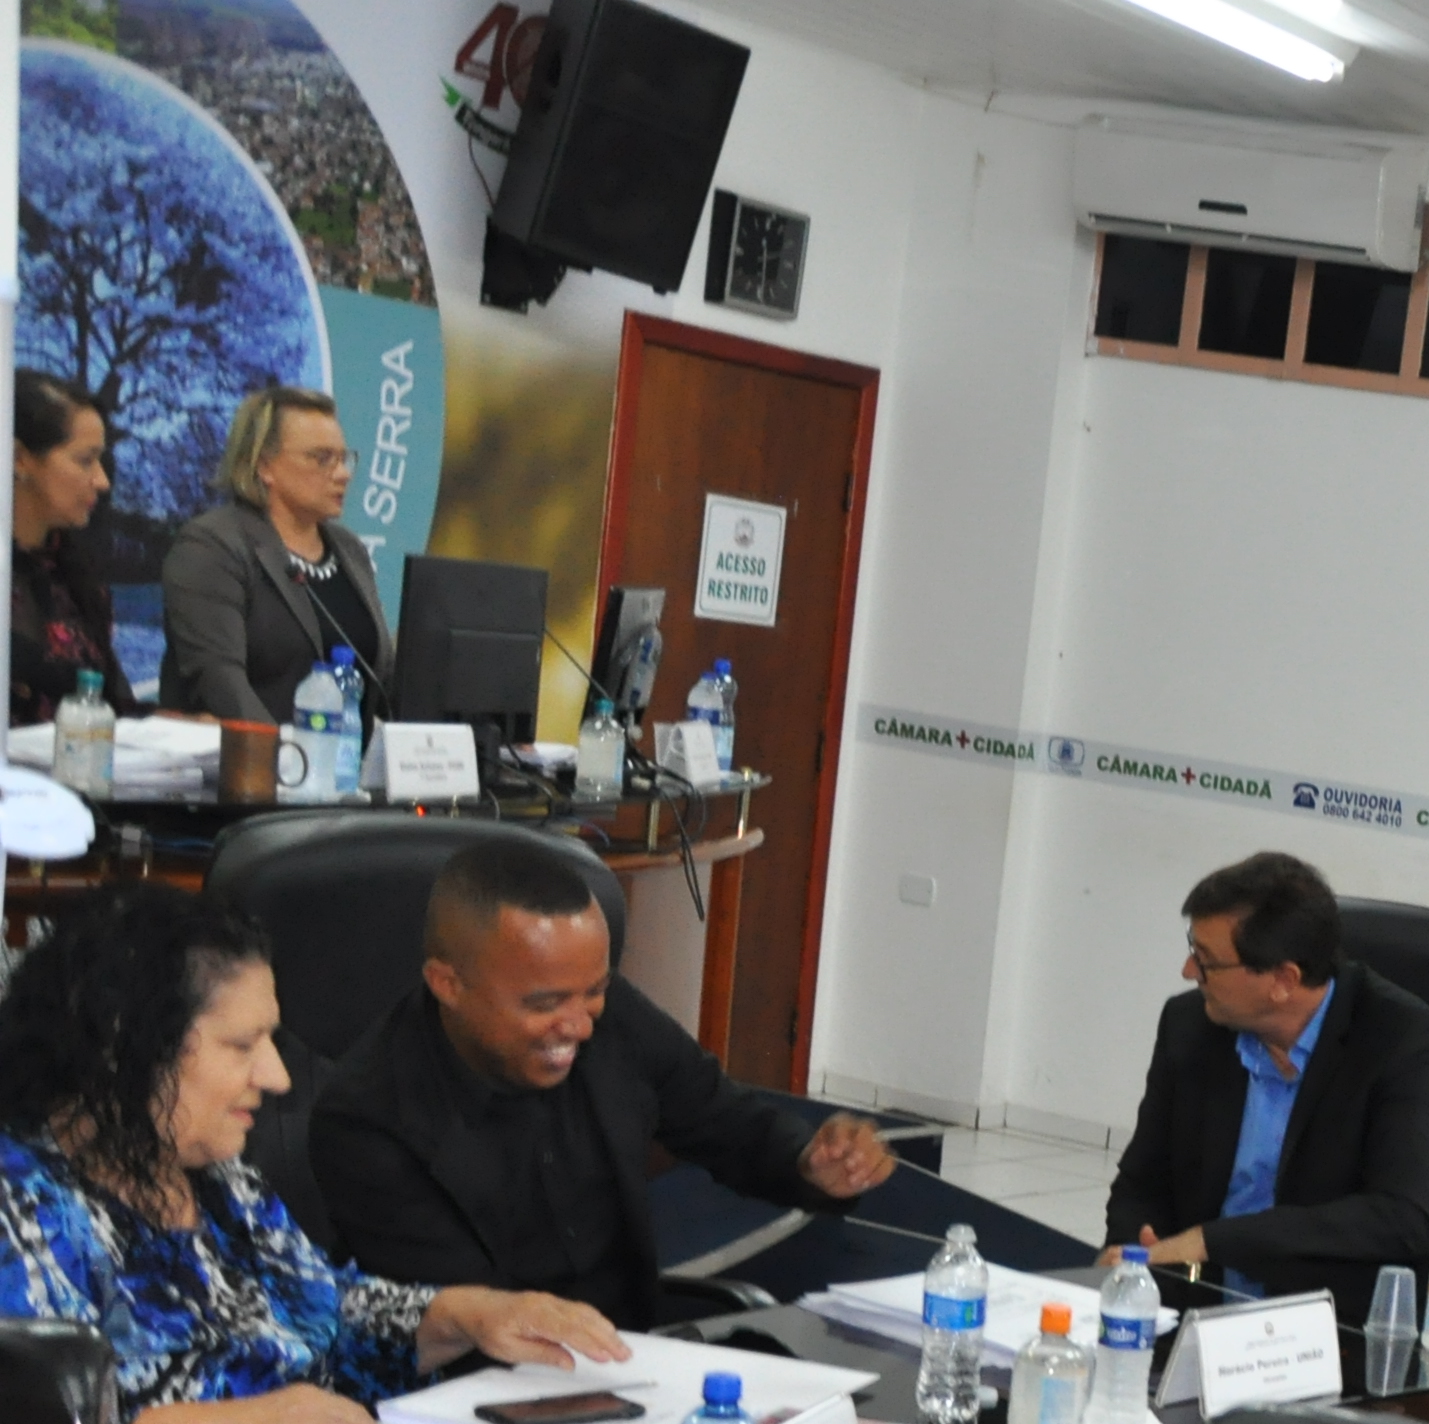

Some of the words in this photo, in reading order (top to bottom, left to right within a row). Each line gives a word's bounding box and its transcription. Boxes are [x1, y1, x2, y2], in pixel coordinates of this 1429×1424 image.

[363, 338, 414, 525] SERRA
[716, 551, 766, 577] ACESSO
[707, 578, 768, 605] RESTRITO
[1323, 787, 1402, 814] OUVIDORIA
[1322, 803, 1350, 818] 0800
[1375, 813, 1402, 828] 4010
